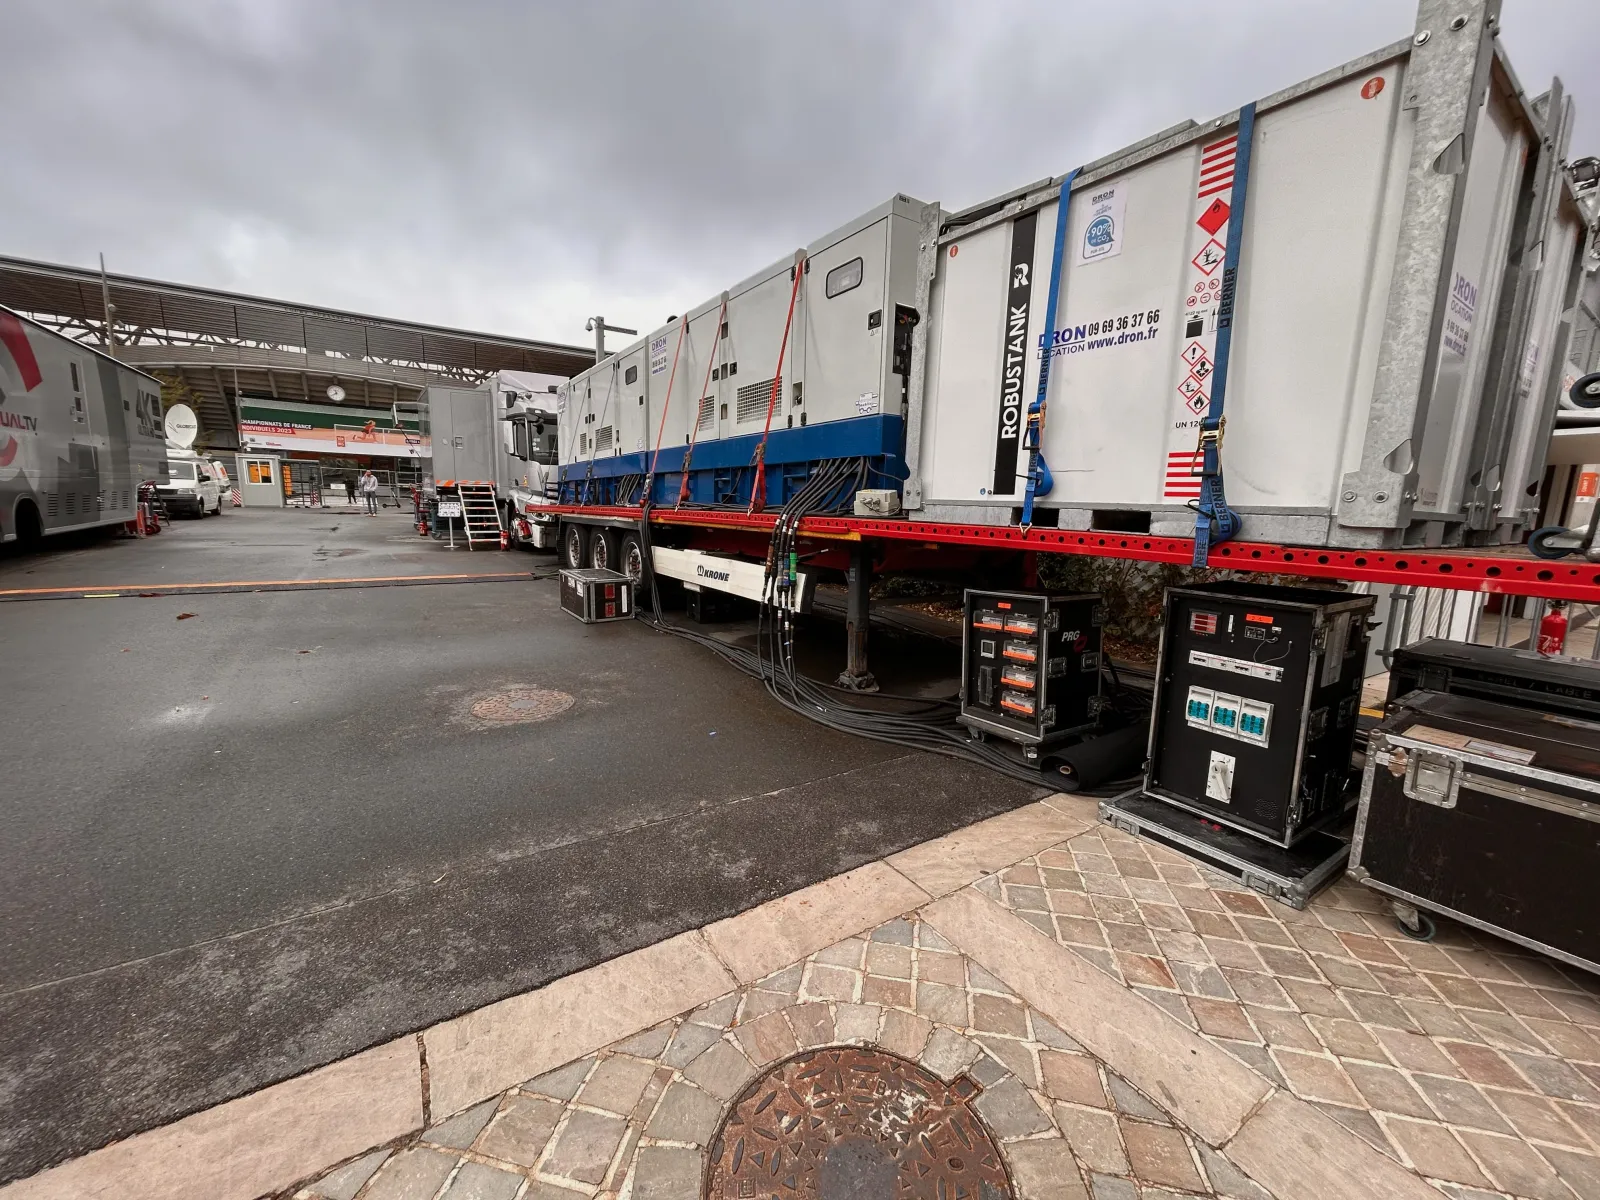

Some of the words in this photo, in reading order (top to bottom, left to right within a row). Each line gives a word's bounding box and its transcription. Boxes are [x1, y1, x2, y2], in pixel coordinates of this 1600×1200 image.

[1222, 267, 1236, 316] BERNER
[1088, 323, 1100, 336] 09
[1102, 319, 1114, 334] 69
[1116, 316, 1129, 330] 36
[1131, 312, 1144, 328] 37
[1146, 309, 1160, 325] 66
[1450, 299, 1473, 323] OCATION
[652, 337, 667, 350] DRON
[1037, 343, 1085, 359] LCATION
[1087, 327, 1159, 350] www.dron.fr
[1001, 303, 1027, 439] ROBUSTANK
[242, 425, 275, 433] NDIVIDUELS
[1211, 479, 1231, 522] BERNER
[704, 569, 730, 582] KRONE
[1061, 630, 1081, 642] PRG
